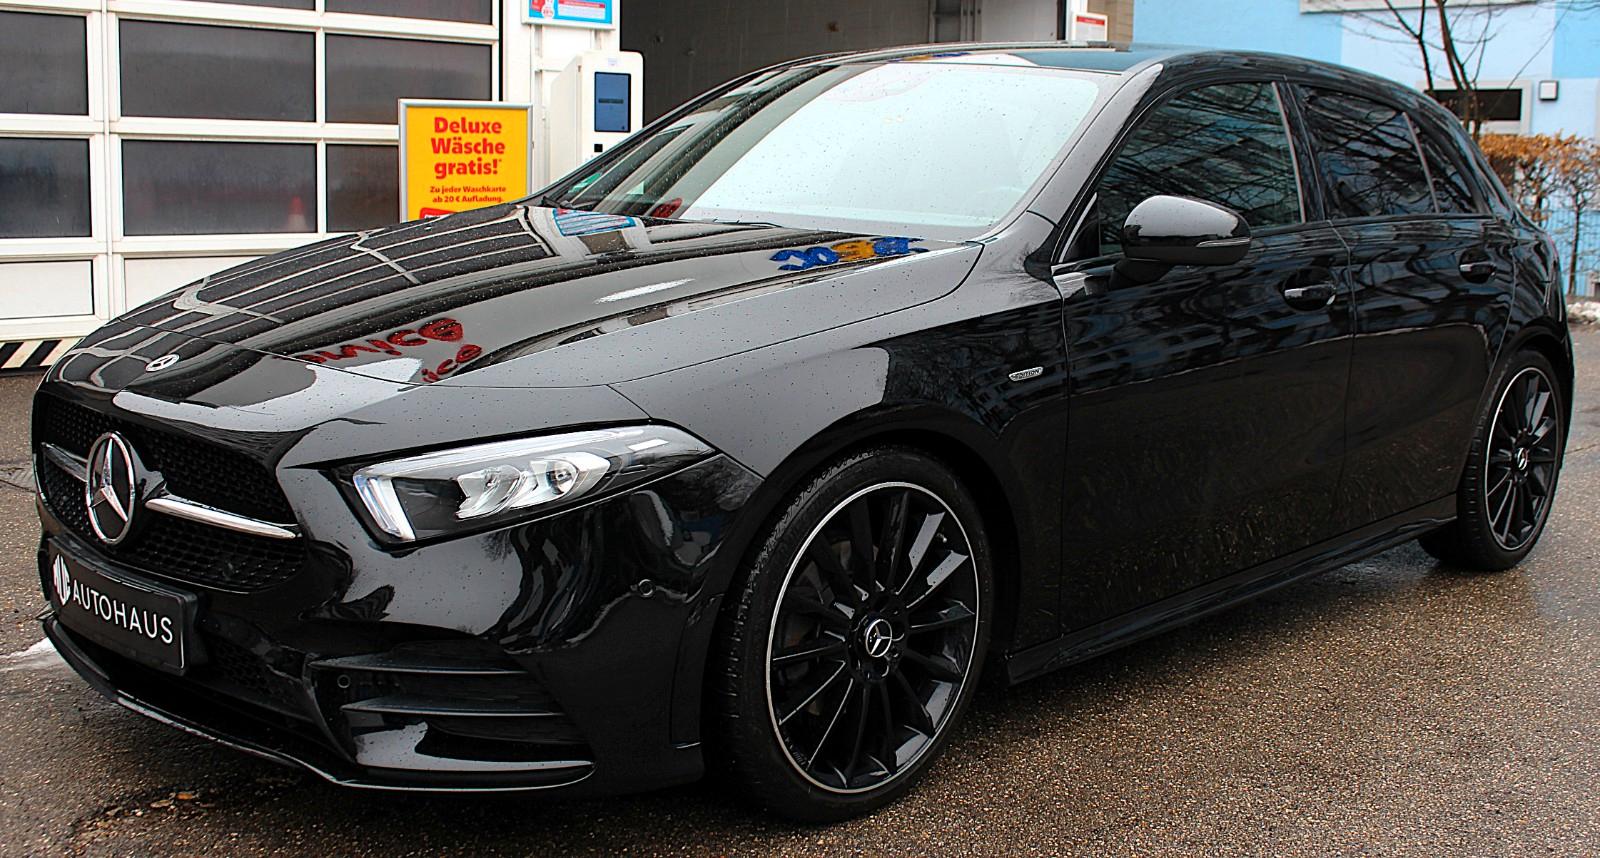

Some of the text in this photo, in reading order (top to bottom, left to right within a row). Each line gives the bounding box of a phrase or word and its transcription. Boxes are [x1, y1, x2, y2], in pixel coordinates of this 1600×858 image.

[434, 116, 502, 134] Deluxe
[431, 136, 505, 154] Wäsche
[441, 185, 461, 194] jeder
[433, 195, 442, 203] ab
[73, 579, 173, 644] AUTOHAUS
